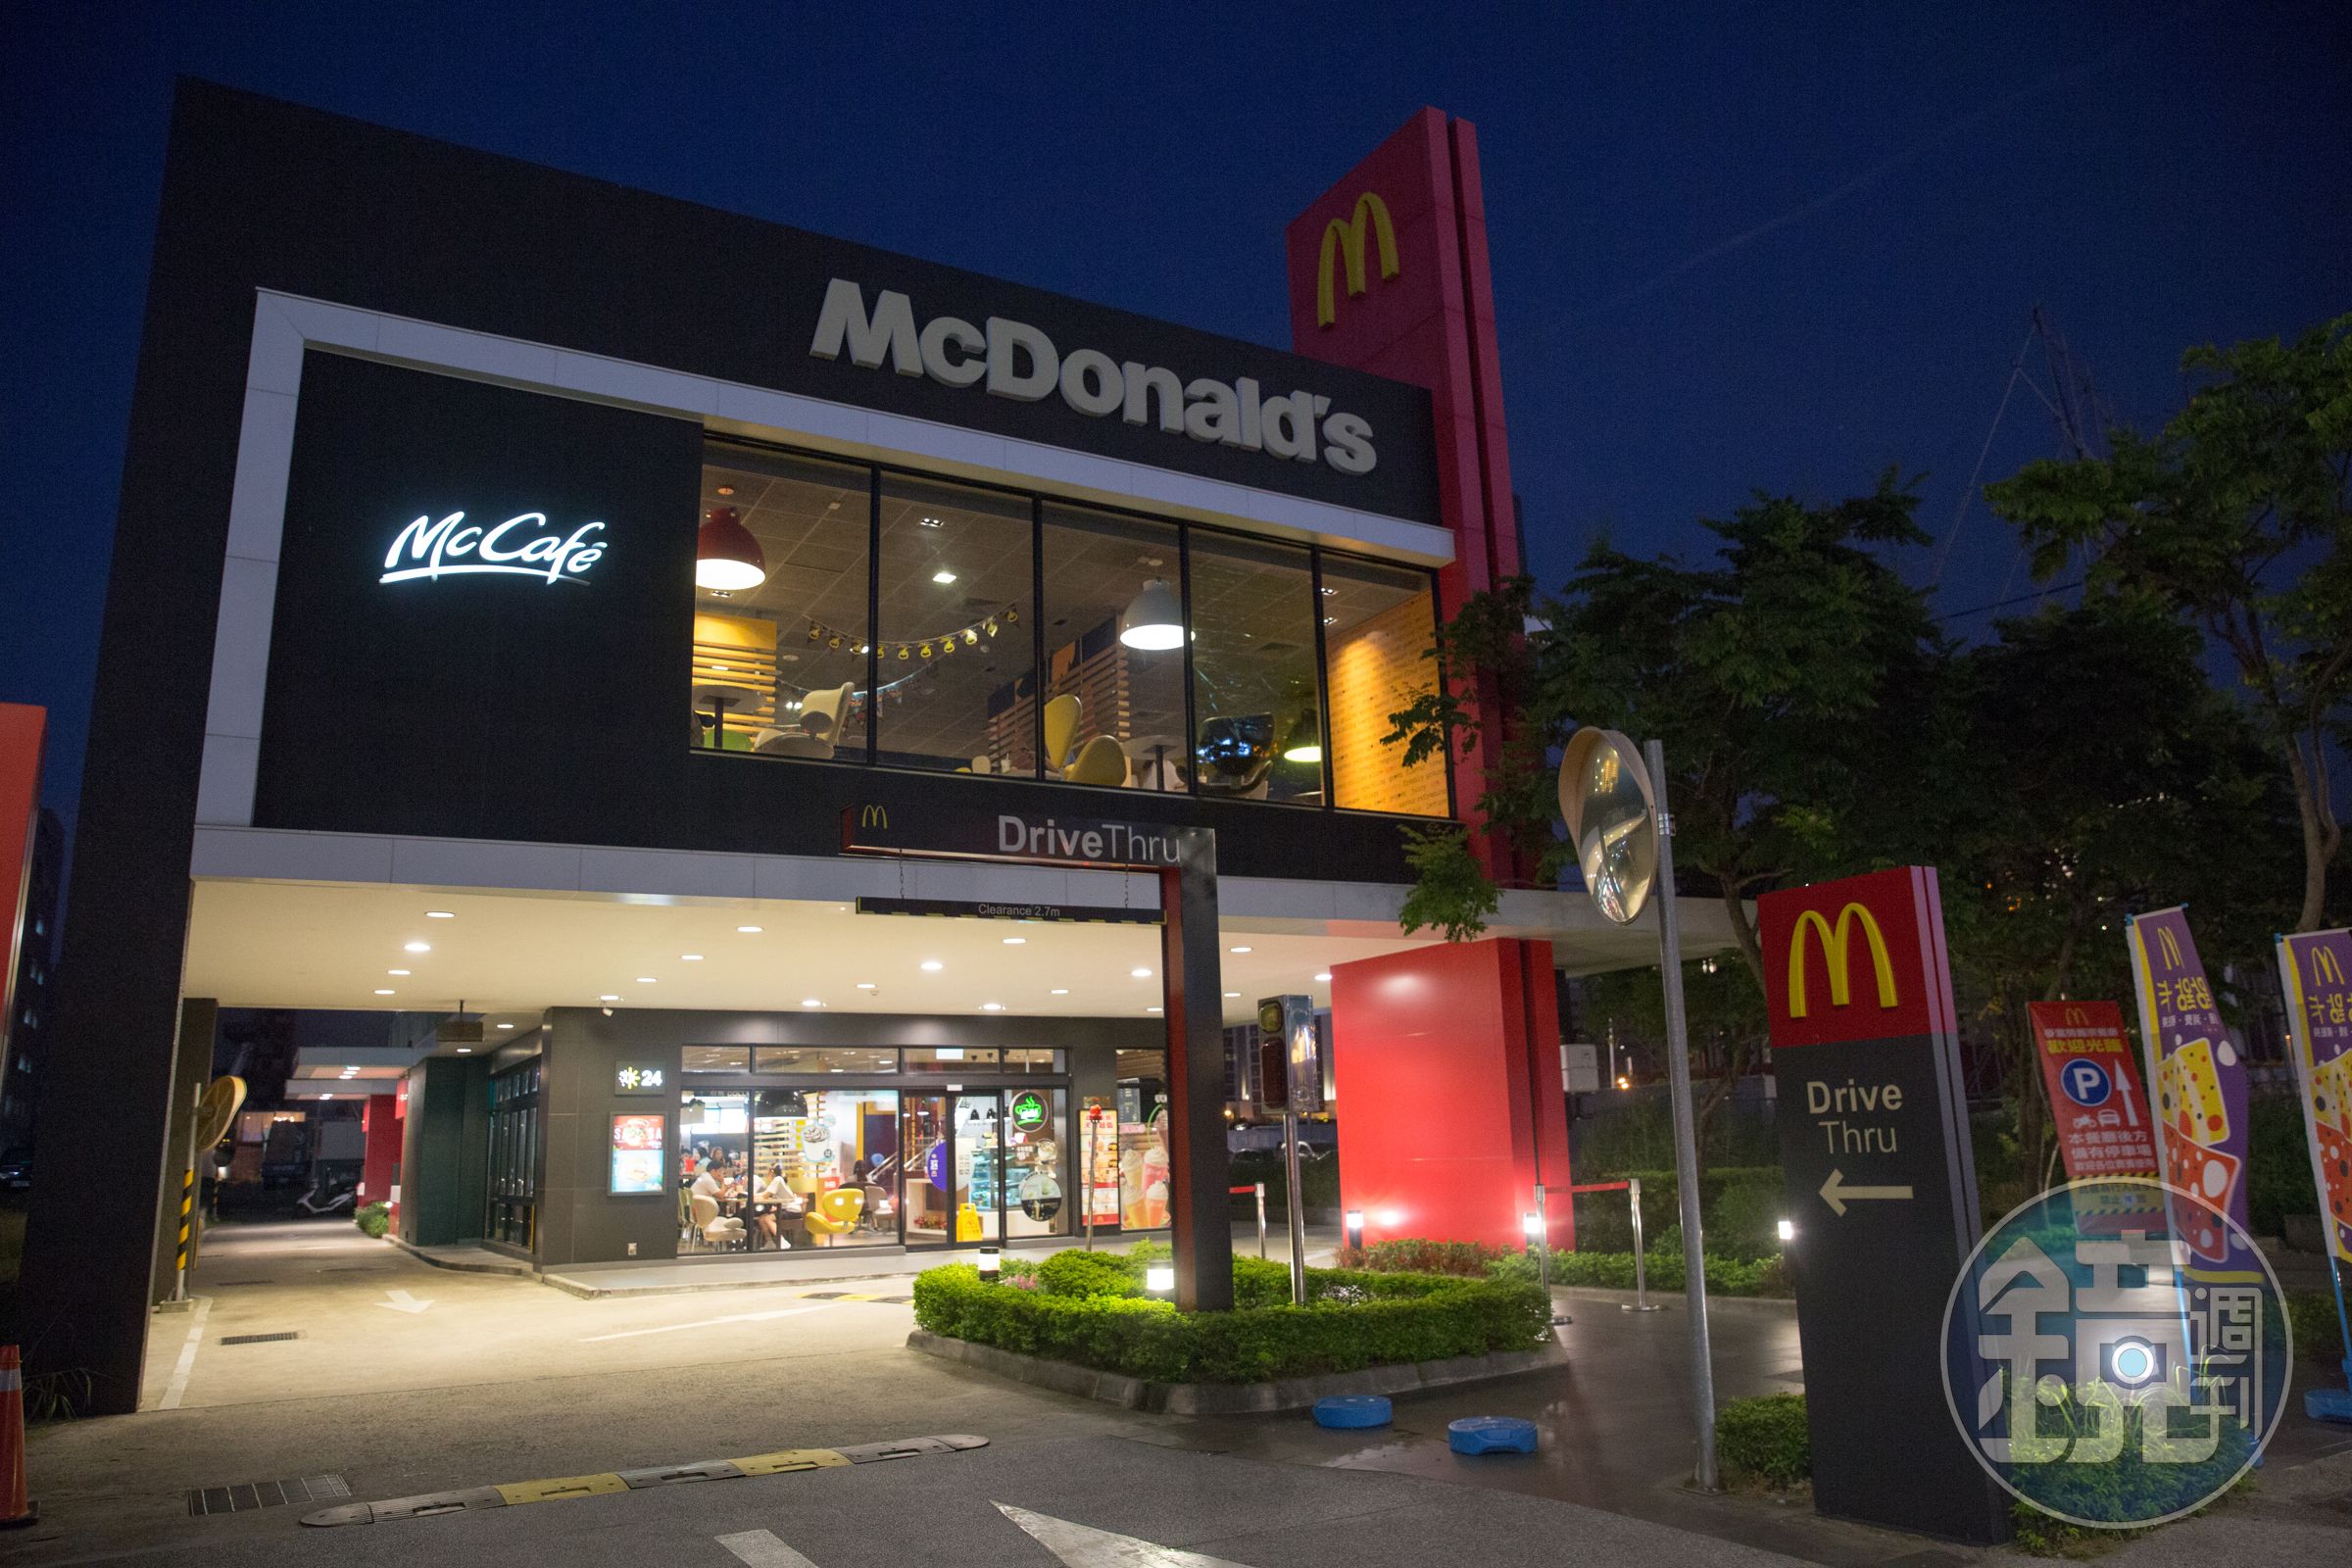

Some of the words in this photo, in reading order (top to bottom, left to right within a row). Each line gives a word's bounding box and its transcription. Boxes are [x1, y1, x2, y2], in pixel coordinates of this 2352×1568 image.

[809, 277, 1377, 476] McDonald's
[380, 511, 608, 585] McCafé
[978, 903, 1032, 916] Clearance
[1034, 906, 1061, 917] 2.7m
[641, 1070, 662, 1087] 24
[2073, 1067, 2101, 1100] P
[1806, 1078, 1904, 1115] Drive
[1818, 1120, 1898, 1154] Thru
